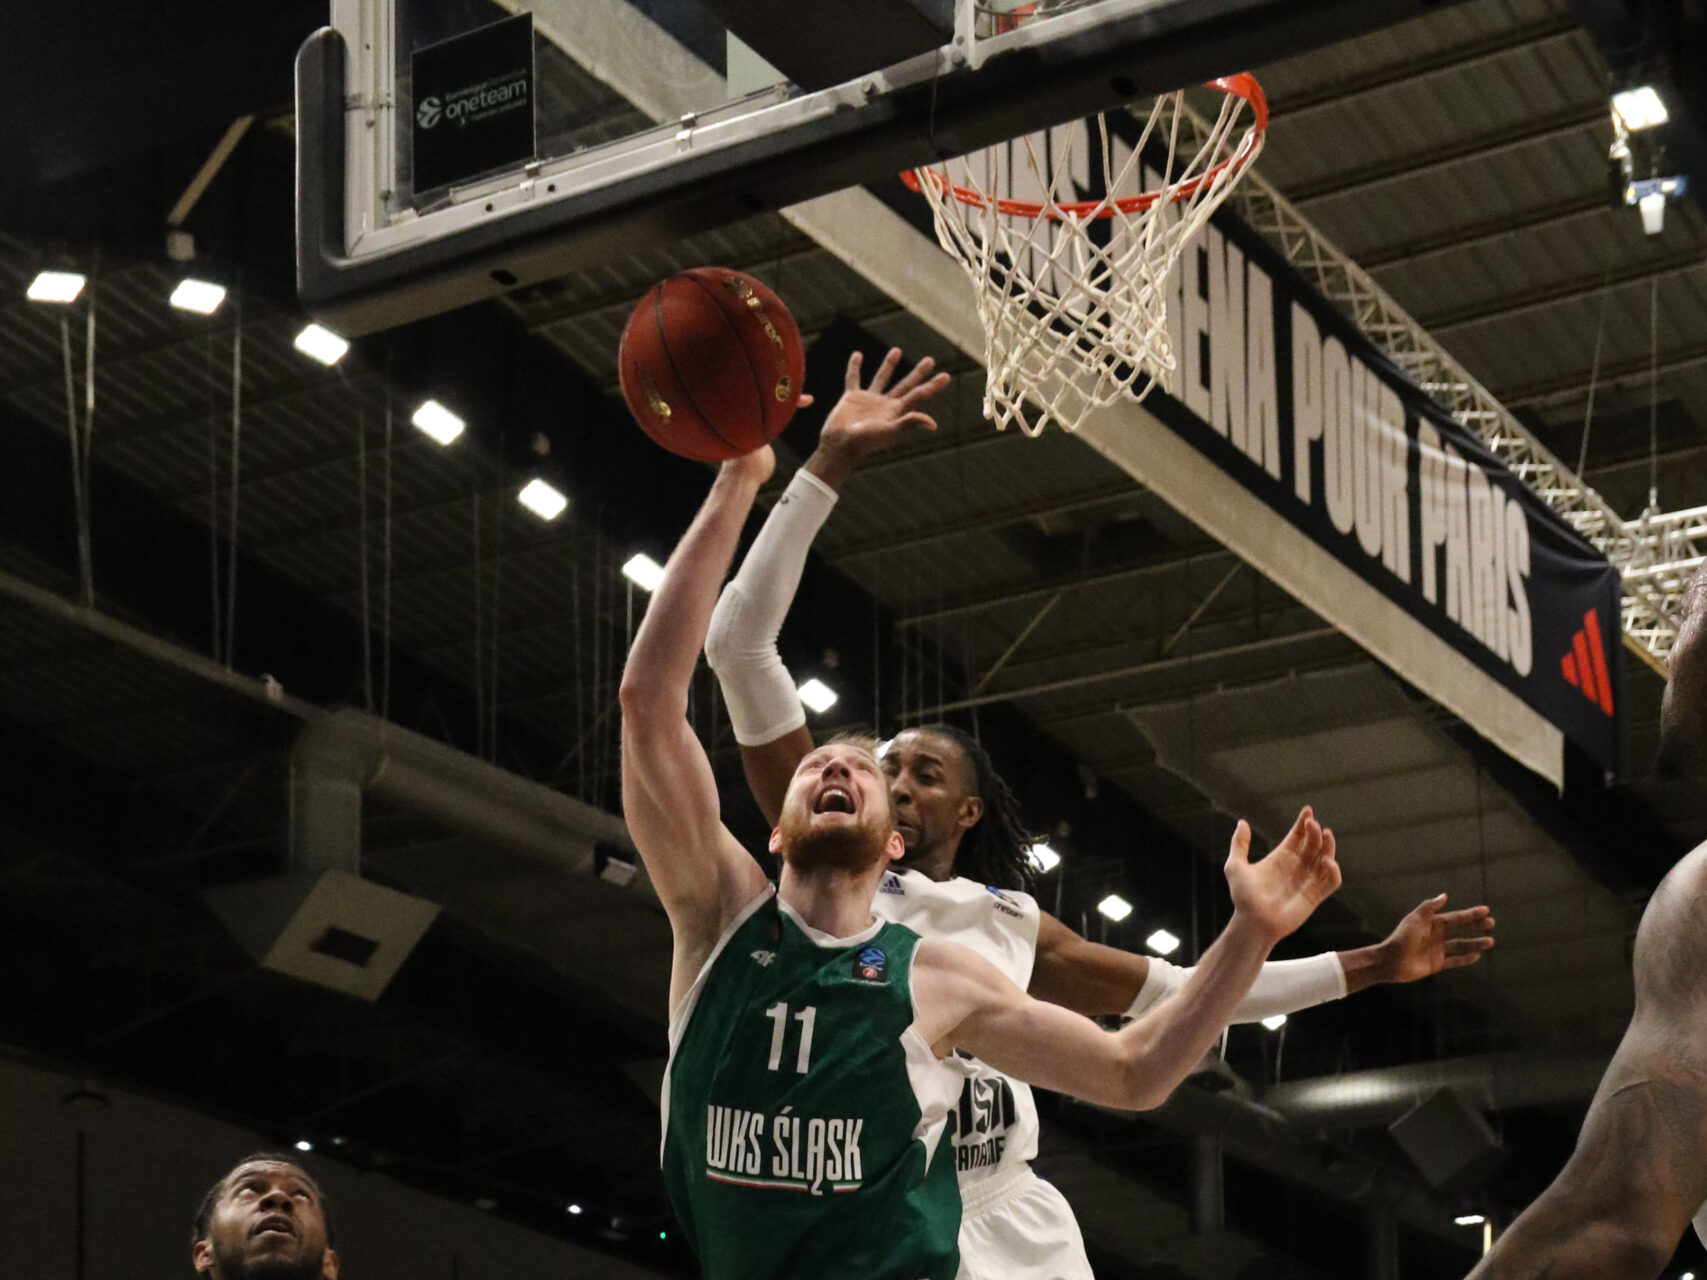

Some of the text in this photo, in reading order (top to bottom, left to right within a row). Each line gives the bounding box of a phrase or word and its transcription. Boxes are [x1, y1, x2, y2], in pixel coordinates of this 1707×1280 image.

[446, 79, 527, 119] oneteam
[1290, 299, 1412, 585] POUR
[1418, 417, 1533, 678] PARIS
[765, 1001, 817, 1075] 11
[706, 1104, 765, 1175] WKS
[772, 1105, 864, 1196] ŚLĄSK
